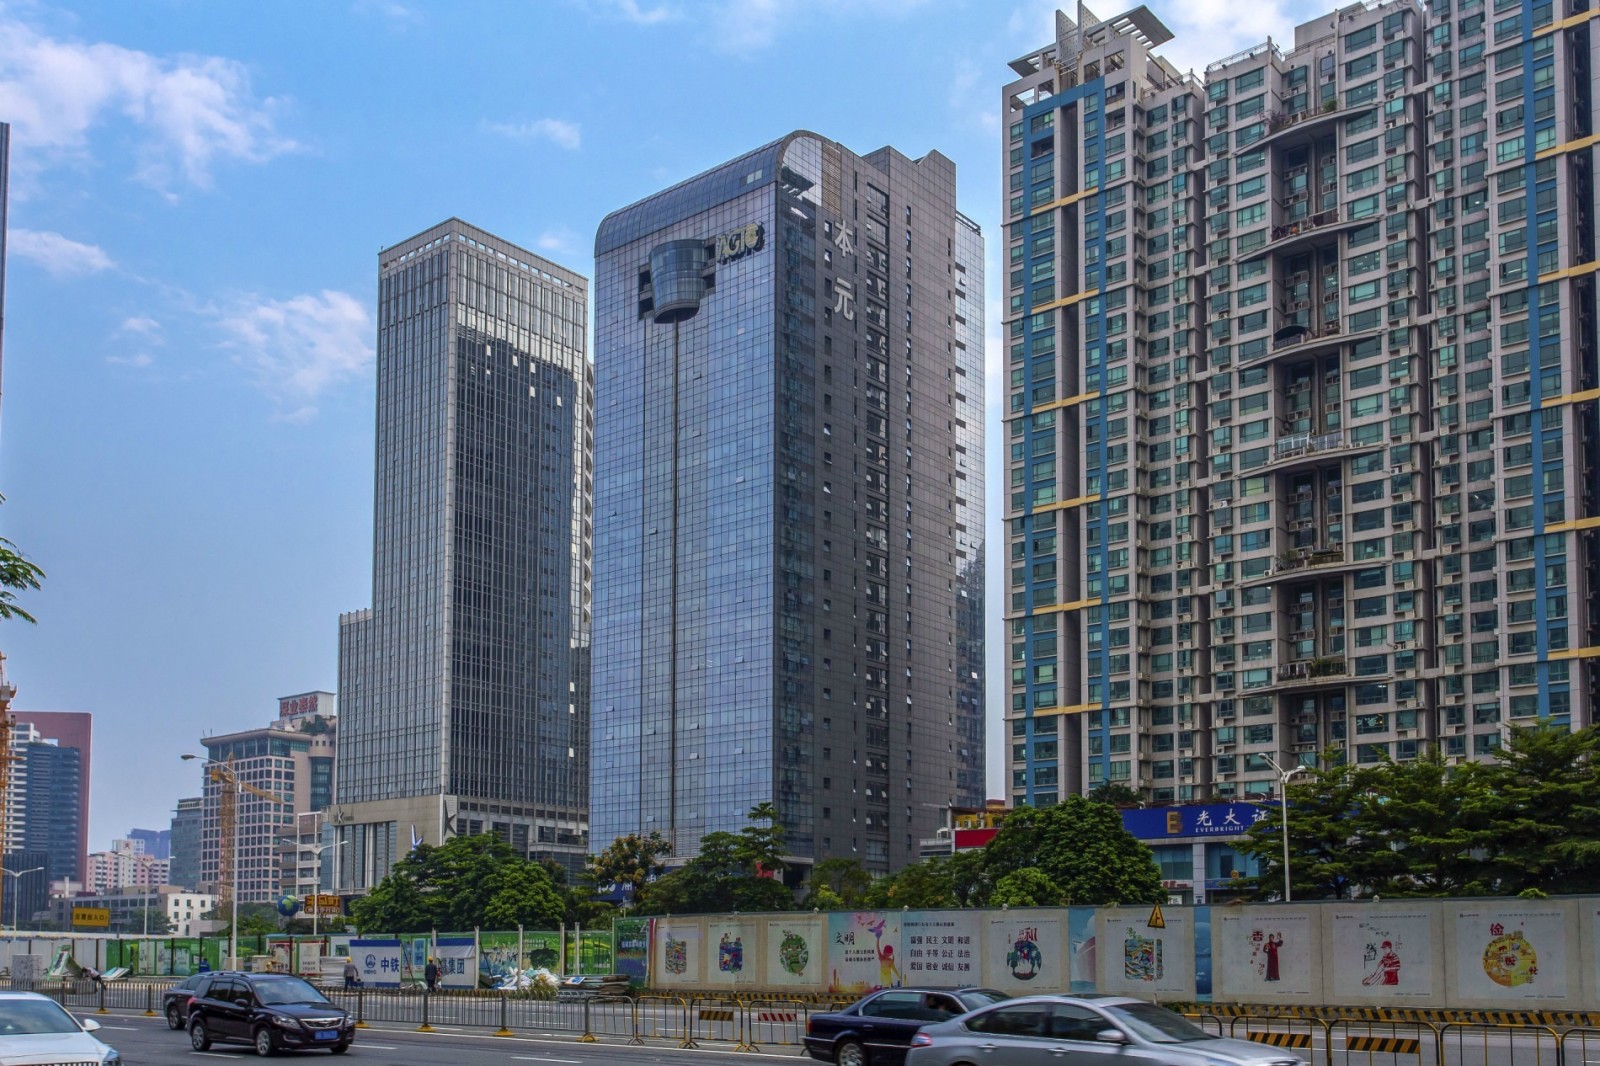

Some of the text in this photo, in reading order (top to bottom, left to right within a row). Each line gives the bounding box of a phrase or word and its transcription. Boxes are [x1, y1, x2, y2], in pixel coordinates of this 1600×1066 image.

[834, 219, 854, 320] 本元
[1195, 825, 1244, 833] EVERBRIGHT
[835, 931, 855, 945] 文明
[910, 936, 970, 945] 富强 民主 文明 和谐
[910, 949, 970, 958] 自由 平等 公正 法治
[380, 956, 400, 973] 中铁
[910, 962, 970, 971] 爱国 敬业 诚信 友善
